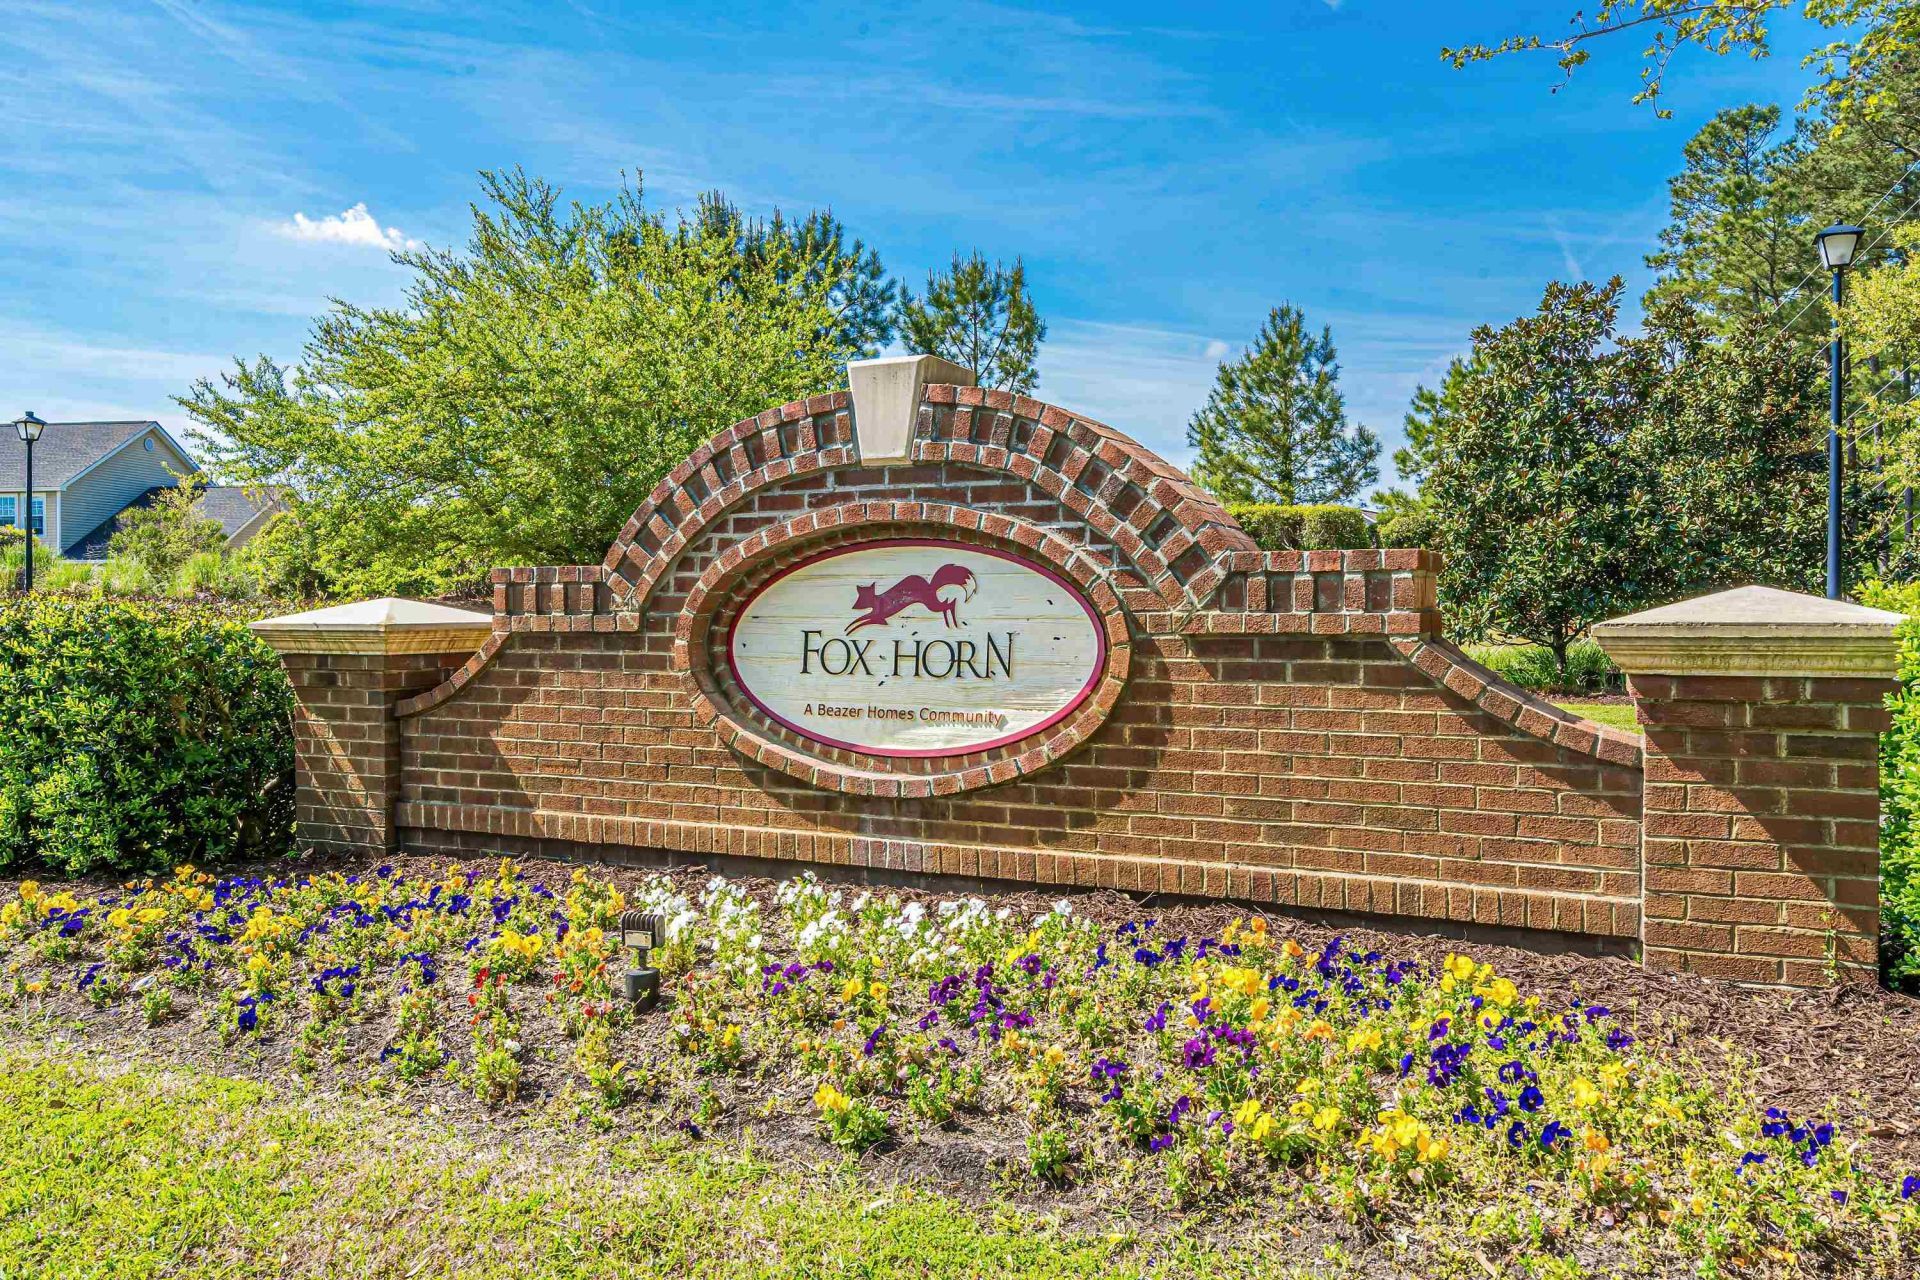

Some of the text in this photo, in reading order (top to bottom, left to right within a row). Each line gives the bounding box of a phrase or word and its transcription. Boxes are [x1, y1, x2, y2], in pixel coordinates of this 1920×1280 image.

[800, 630, 1016, 679] FOX HORN
[804, 704, 1003, 727] A Beazer Homes Community
